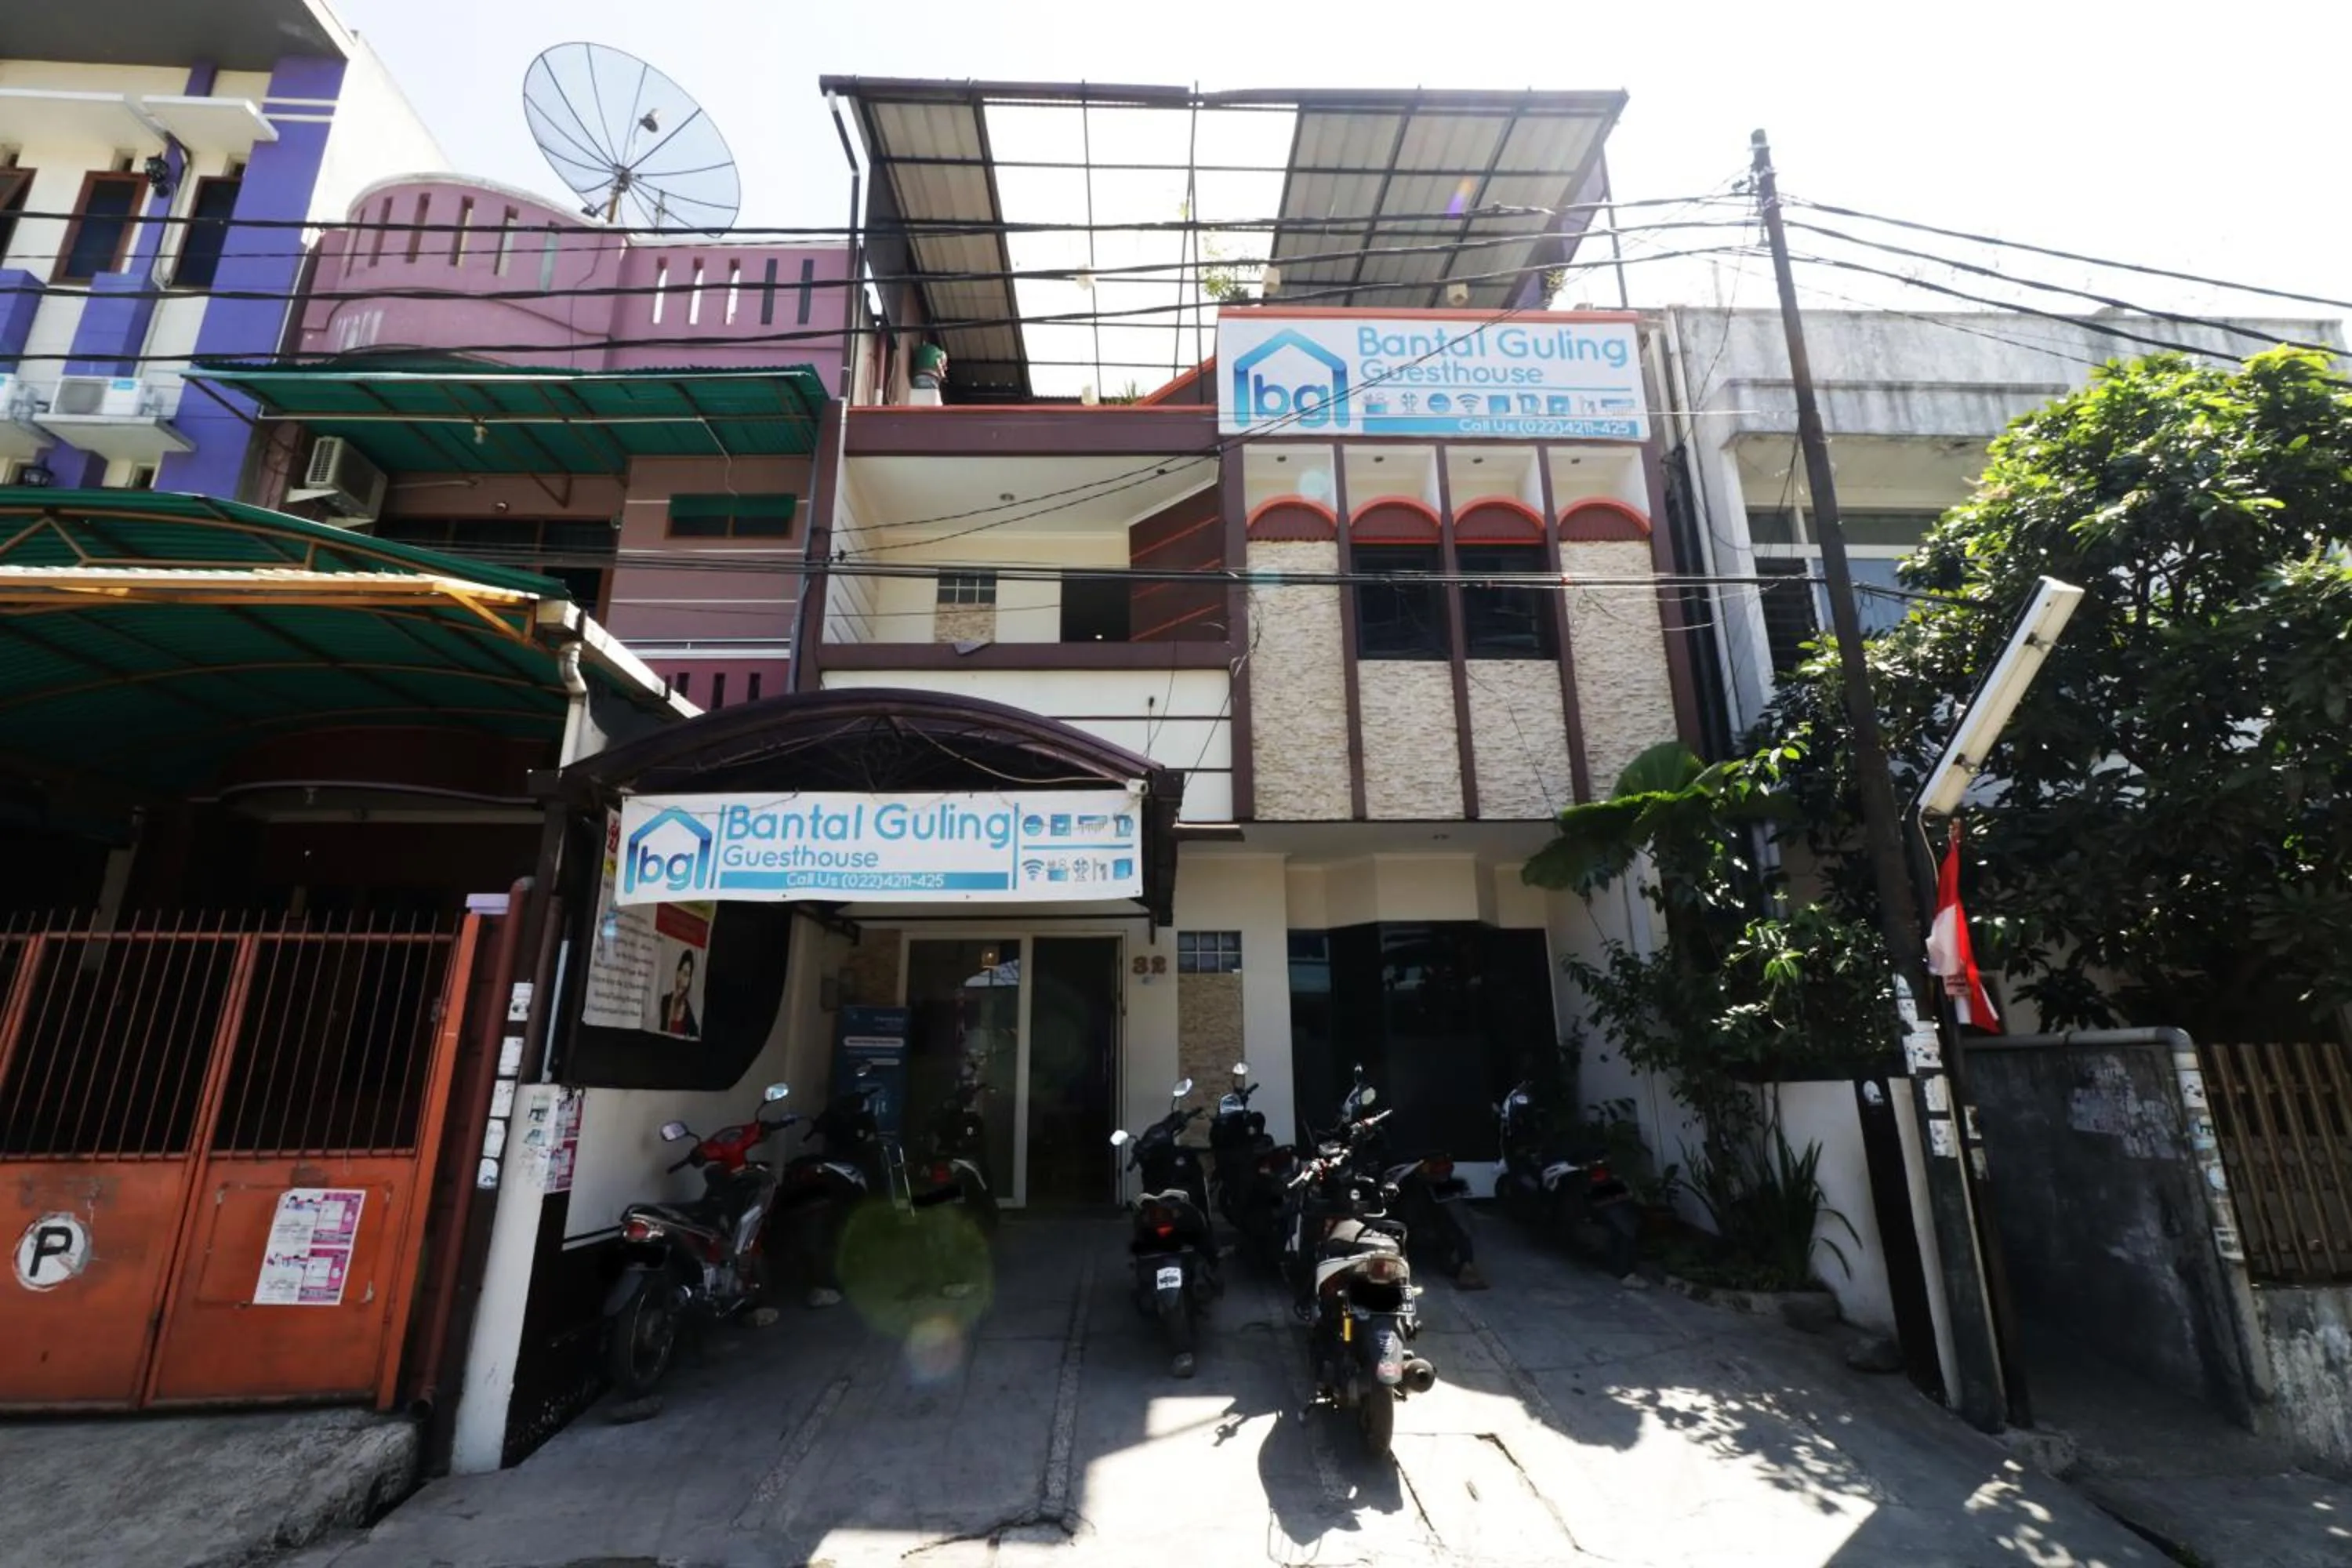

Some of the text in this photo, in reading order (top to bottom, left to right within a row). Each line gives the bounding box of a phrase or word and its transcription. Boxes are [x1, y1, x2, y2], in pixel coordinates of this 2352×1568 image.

[1357, 326, 1628, 368] Bantal Guling
[1360, 359, 1544, 384] Guesthouse
[1458, 419, 1489, 431] Call
[1494, 420, 1514, 432] Us
[725, 804, 1011, 849] Bantal Guling
[638, 845, 695, 891] bg
[721, 844, 879, 868] Guesthouse
[786, 873, 814, 886] Call
[818, 873, 838, 887] Us
[29, 1226, 73, 1277] P
